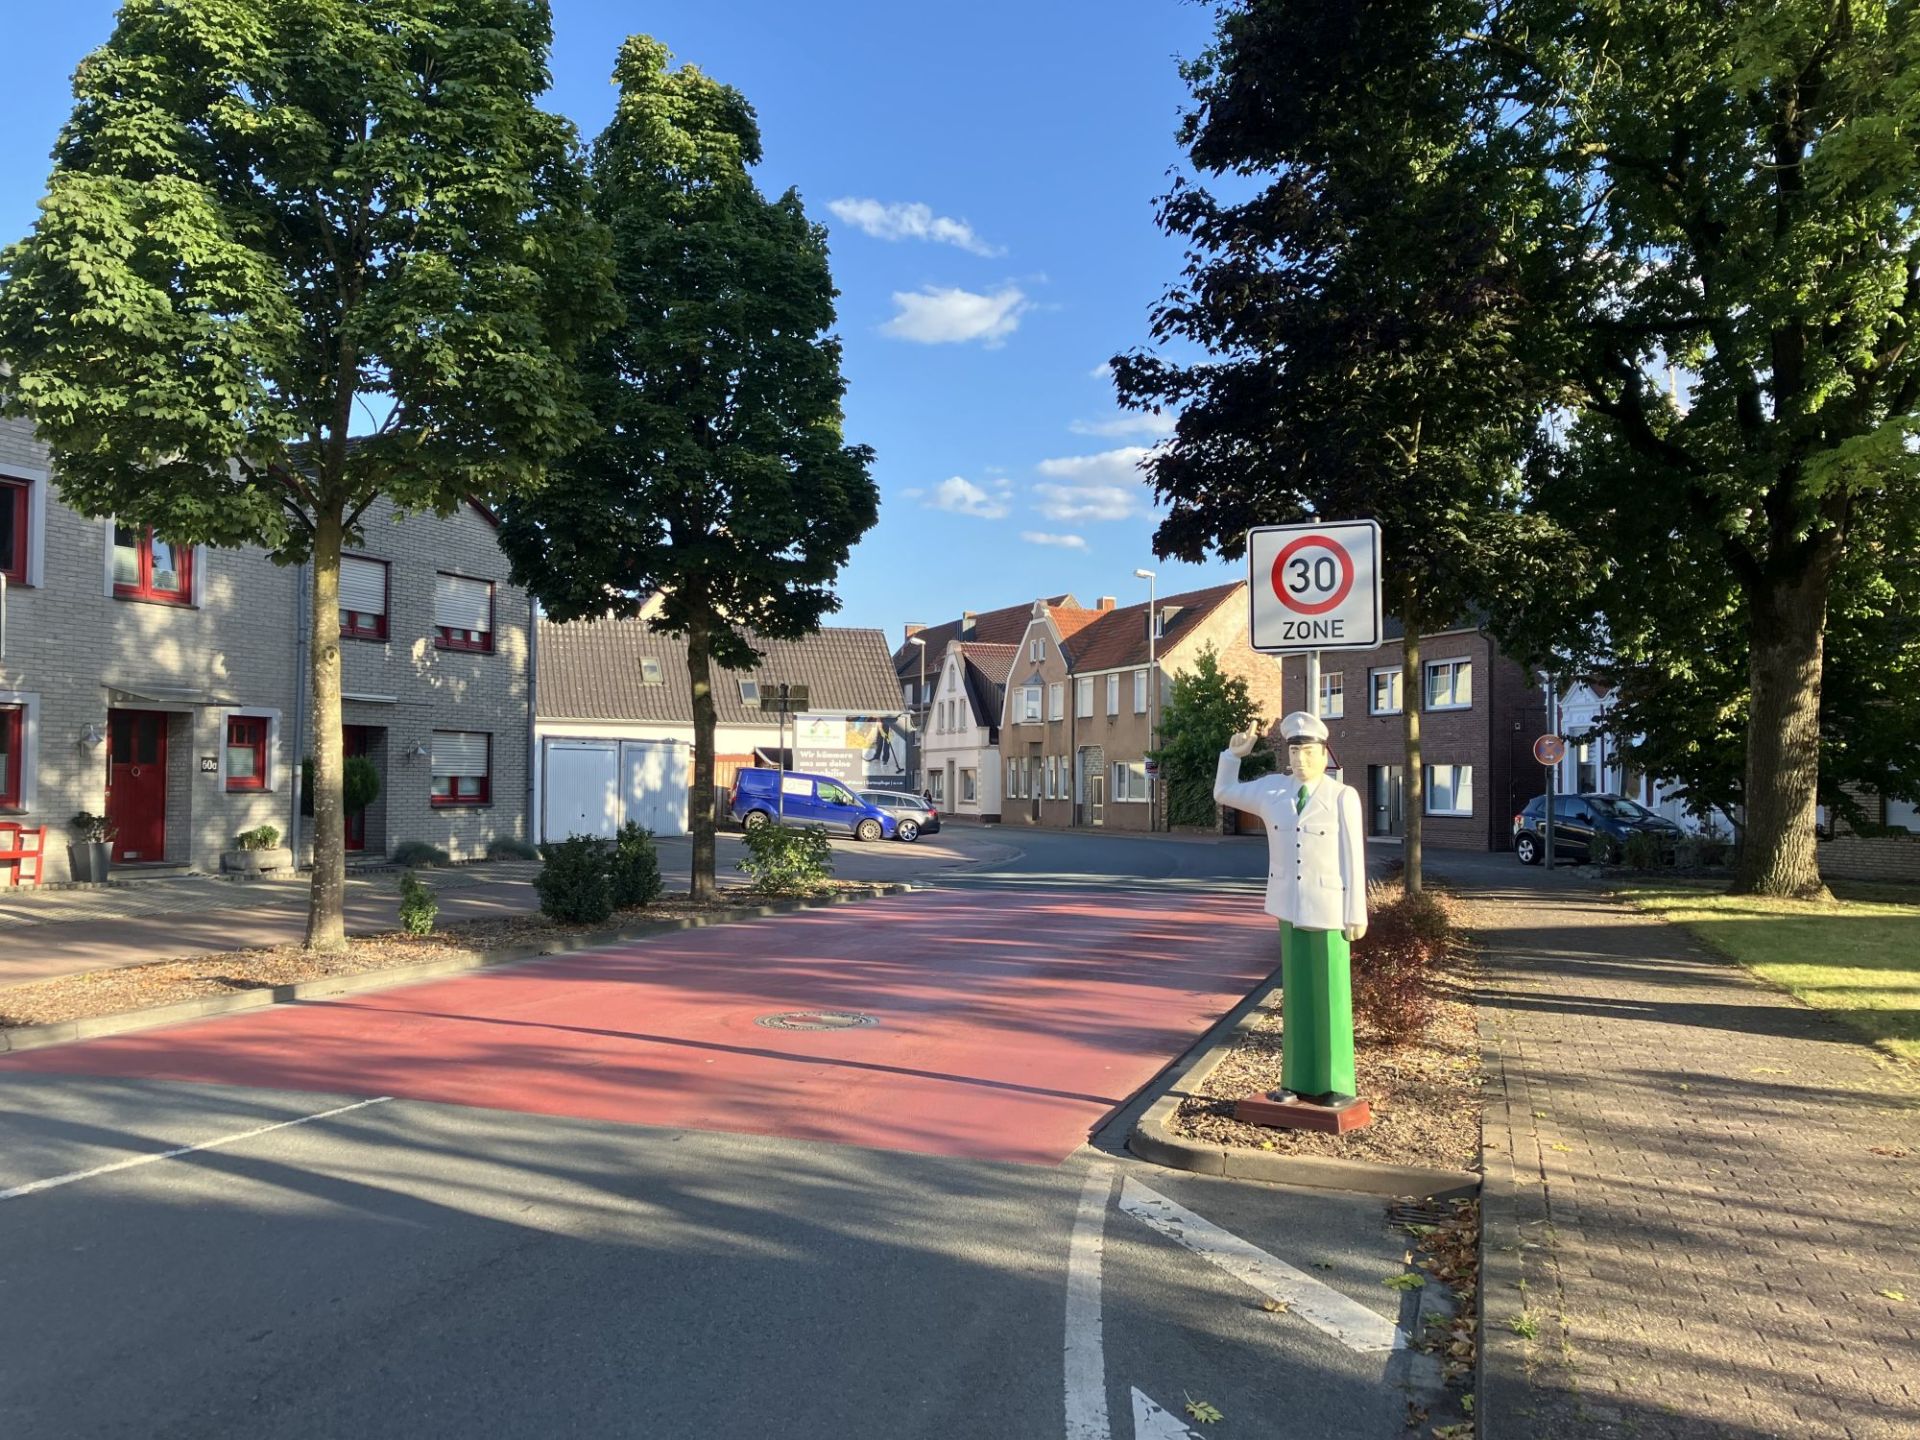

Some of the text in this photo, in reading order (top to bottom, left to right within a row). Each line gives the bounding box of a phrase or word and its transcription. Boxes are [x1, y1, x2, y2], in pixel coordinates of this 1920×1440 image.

[1289, 556, 1336, 593] 30
[1283, 619, 1344, 640] ZONE
[800, 750, 814, 758] Wir
[829, 759, 851, 767] deine
